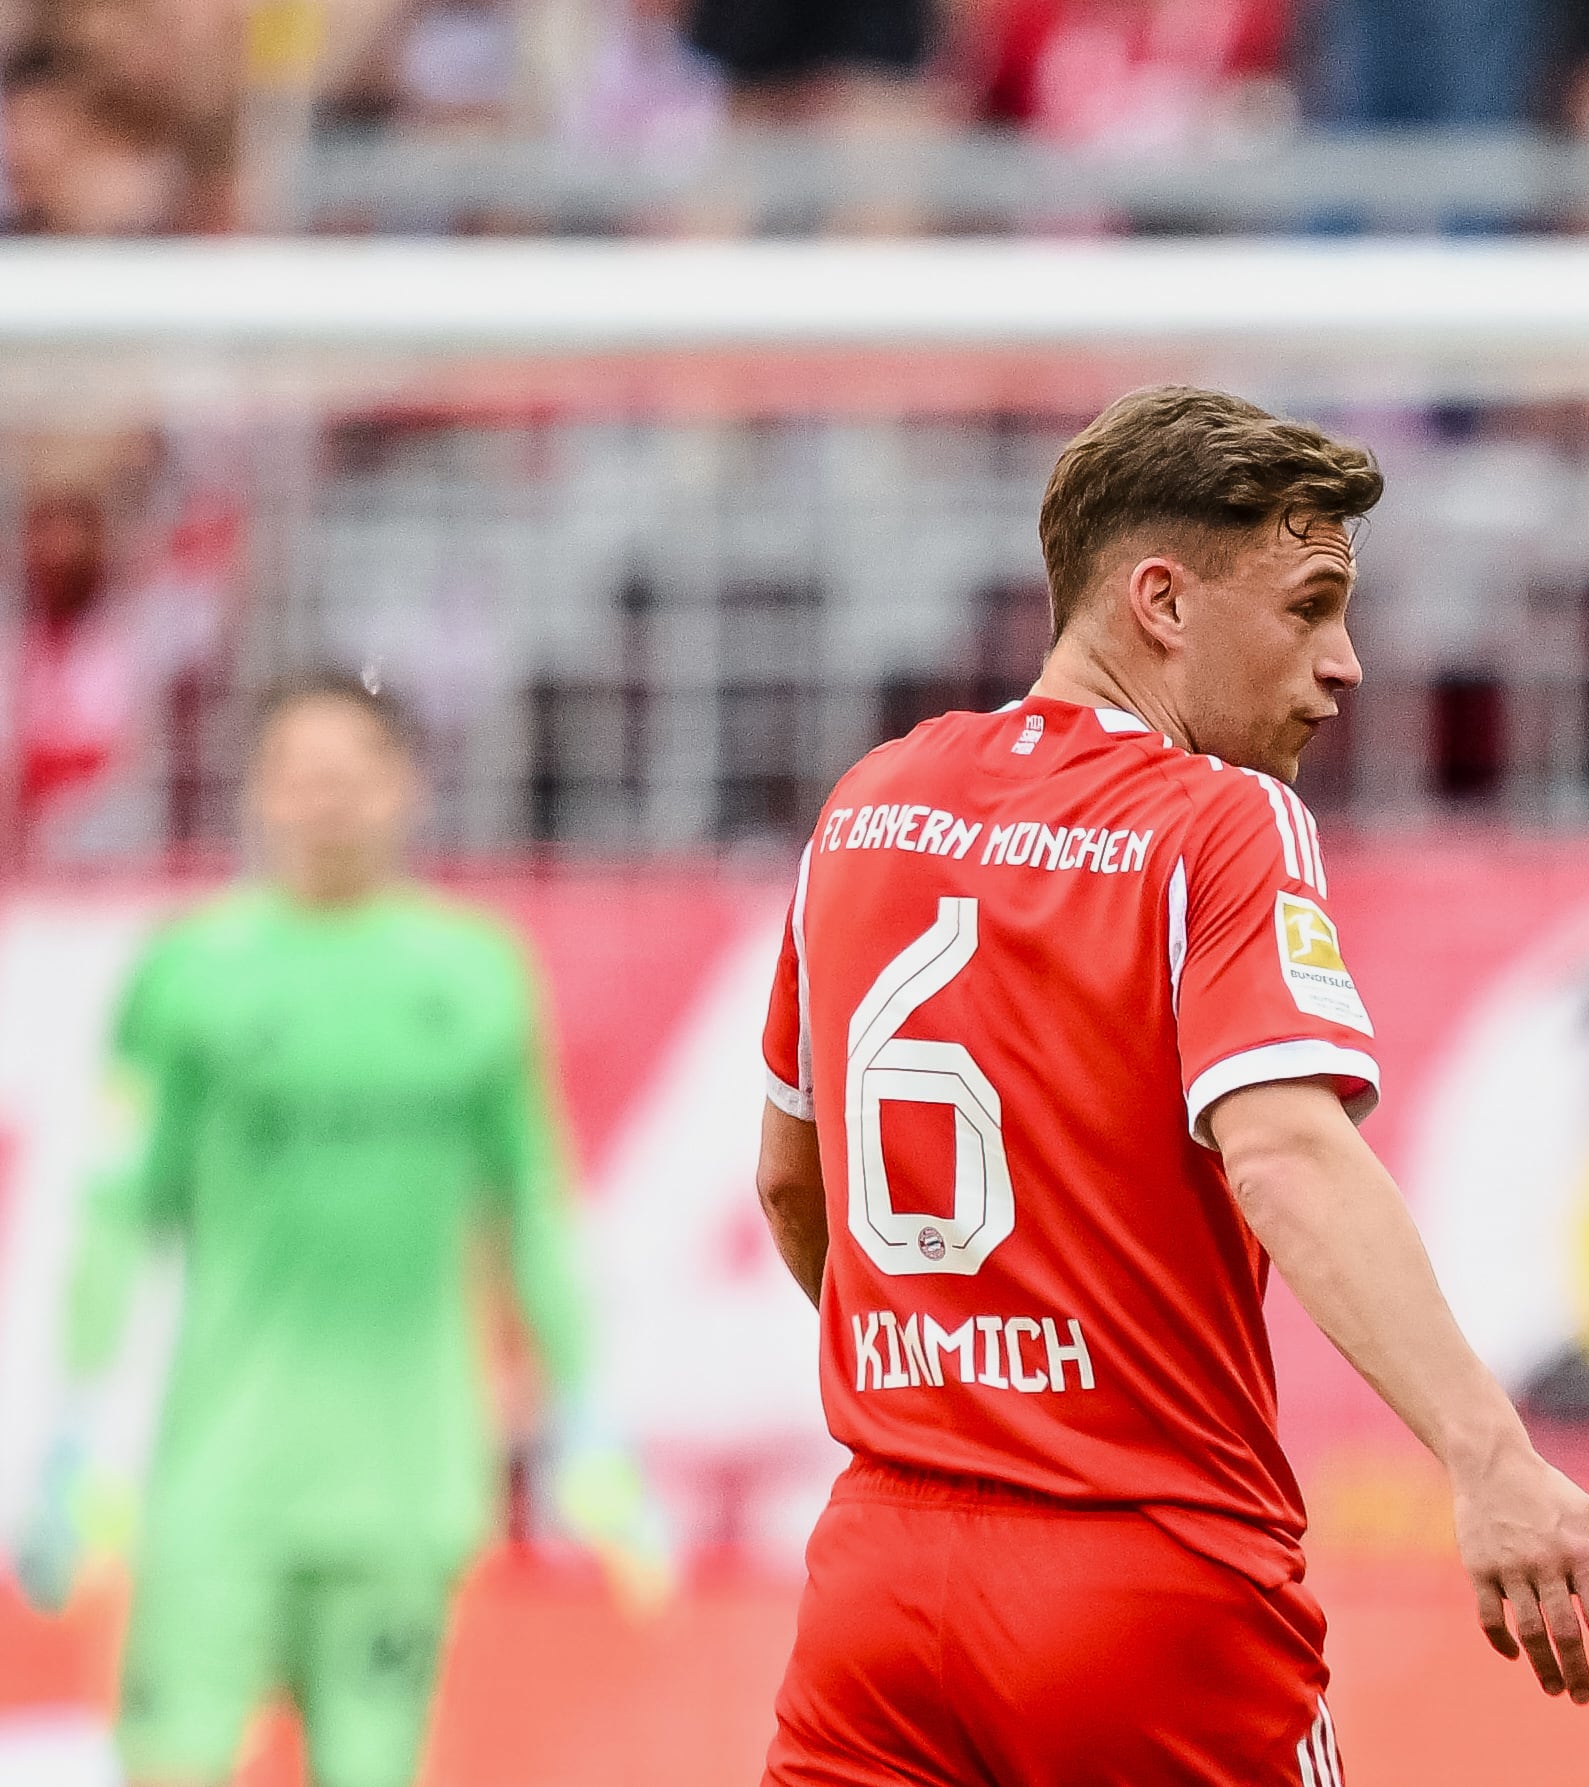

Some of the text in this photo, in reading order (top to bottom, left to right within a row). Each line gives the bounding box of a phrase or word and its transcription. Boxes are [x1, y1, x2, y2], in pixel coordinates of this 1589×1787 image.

[820, 804, 1154, 875] FC BAYERN MÜNCHEN
[1290, 968, 1357, 990] BUNDESLIG
[845, 896, 1016, 1276] 6
[852, 1310, 1096, 1393] KIMMICH
